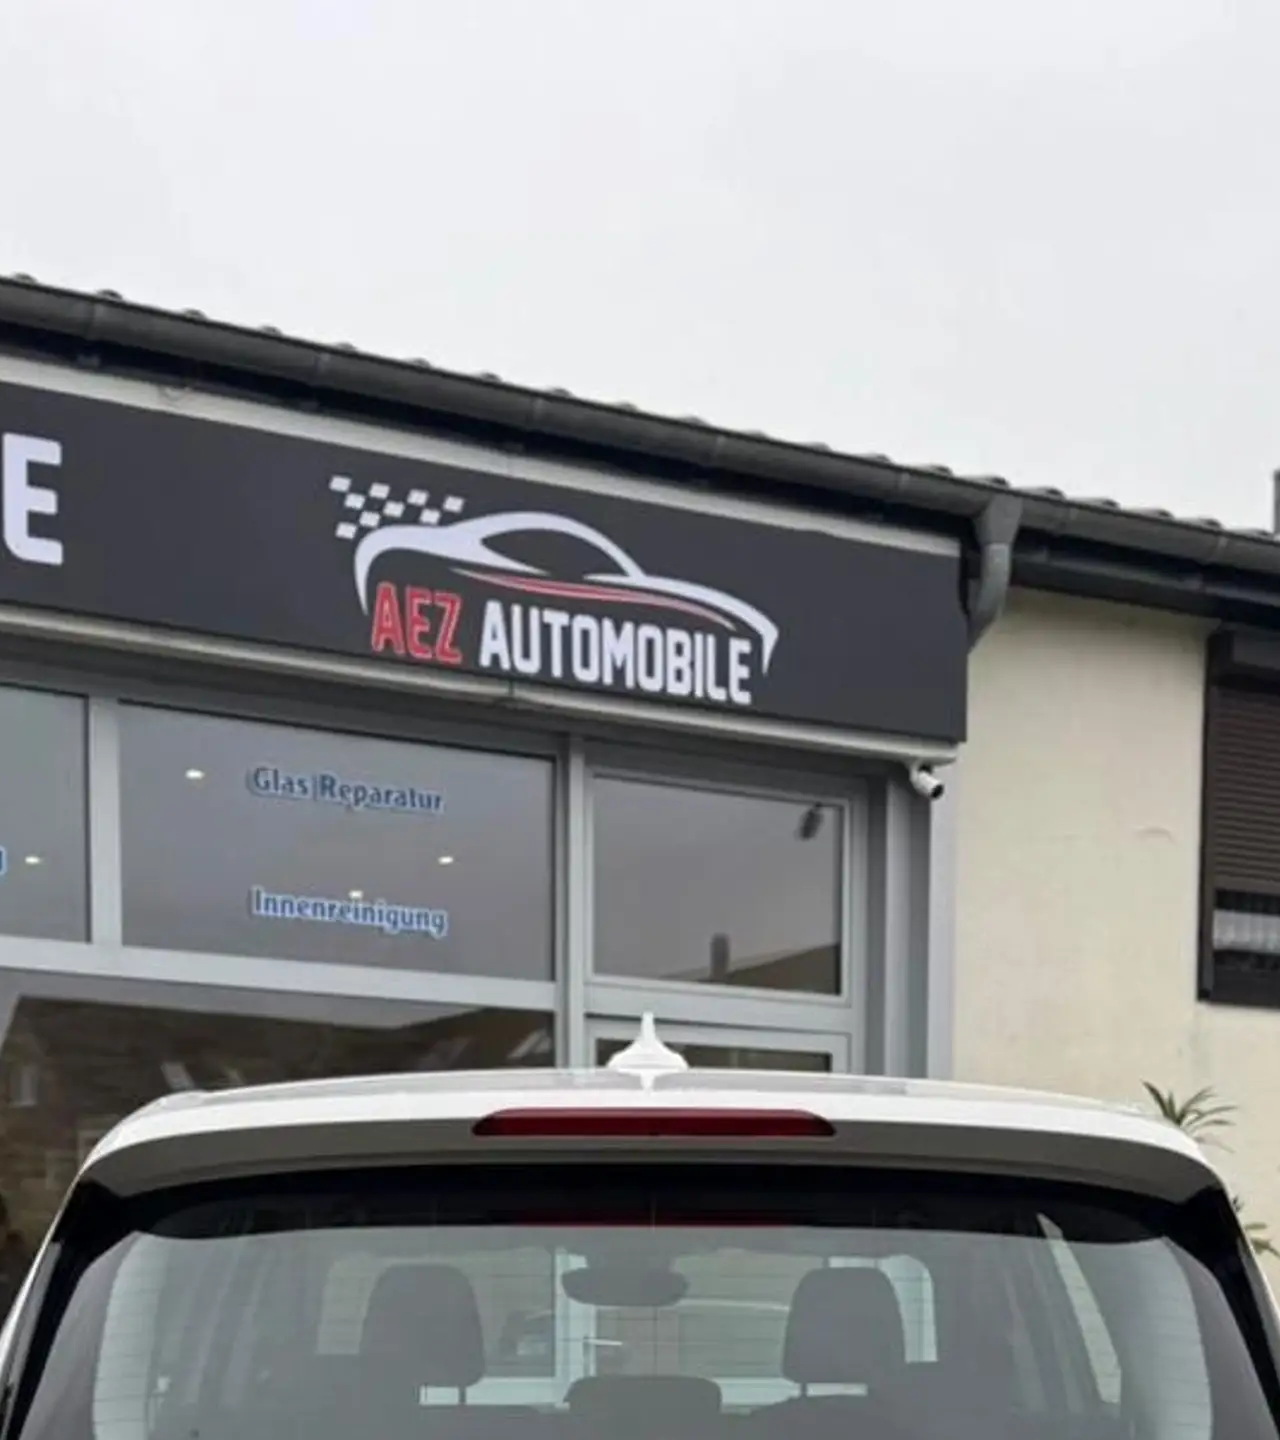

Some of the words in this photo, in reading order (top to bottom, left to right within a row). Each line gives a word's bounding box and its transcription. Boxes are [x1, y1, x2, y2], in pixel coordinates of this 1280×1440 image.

[371, 581, 462, 664] AEZ
[479, 601, 752, 704] AUTOMOBILE
[253, 887, 448, 938] Innenreinigung
